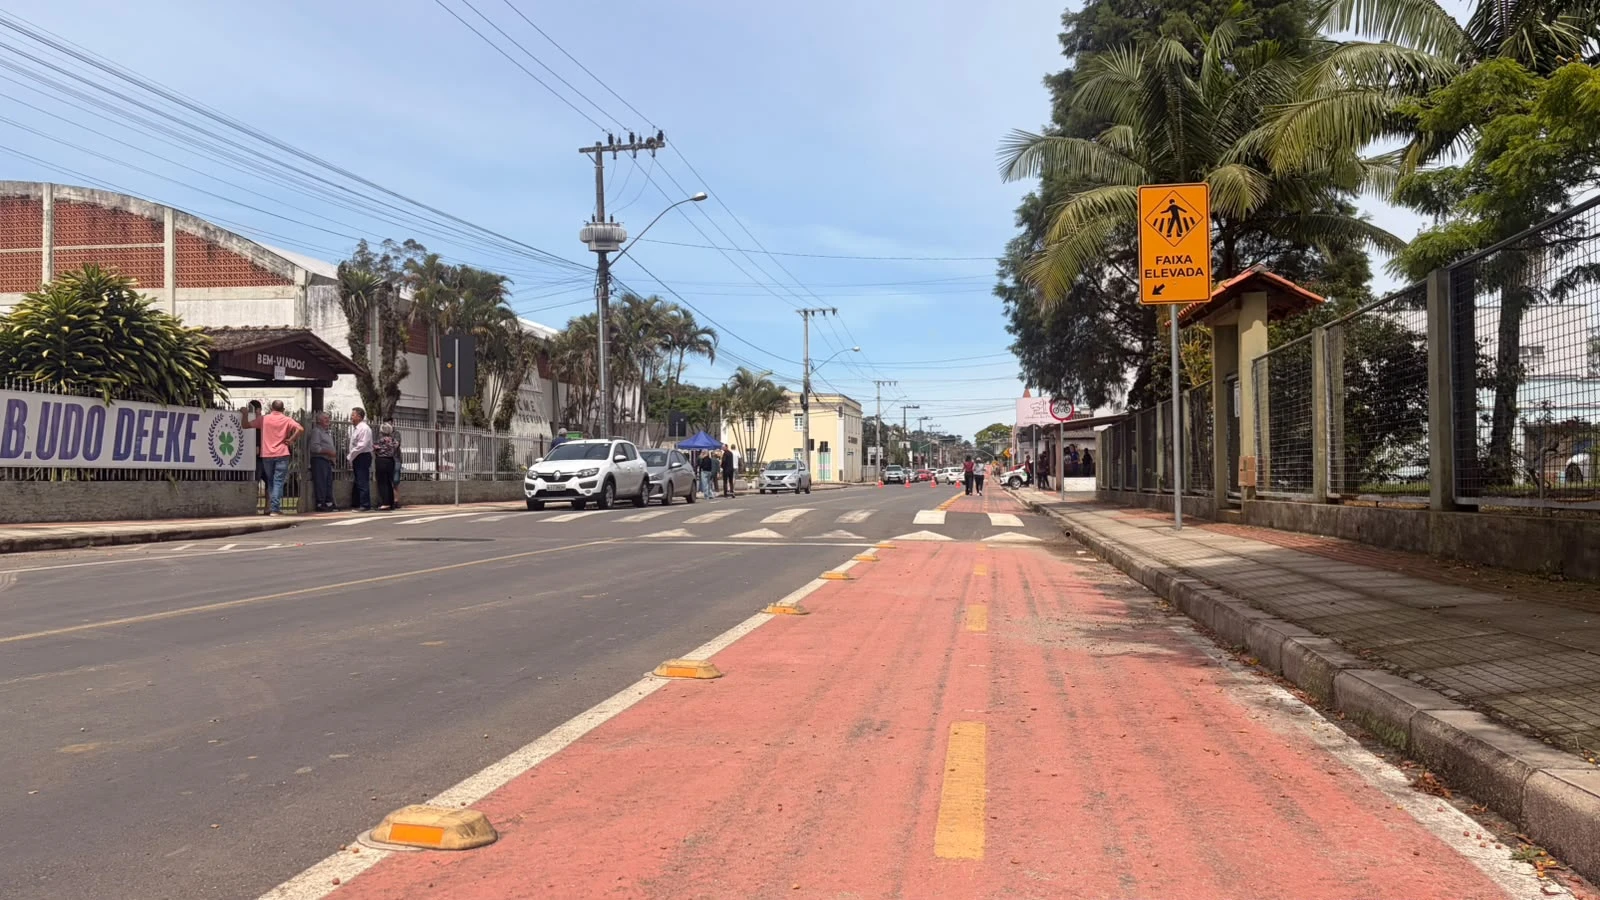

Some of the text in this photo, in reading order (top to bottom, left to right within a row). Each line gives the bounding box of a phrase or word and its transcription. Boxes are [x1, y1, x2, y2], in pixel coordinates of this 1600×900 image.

[1155, 255, 1193, 265] FAIXA
[1145, 267, 1204, 278] ELEVADA
[257, 353, 306, 370] BEM-VINDOS
[112, 407, 200, 463] DEEKE
